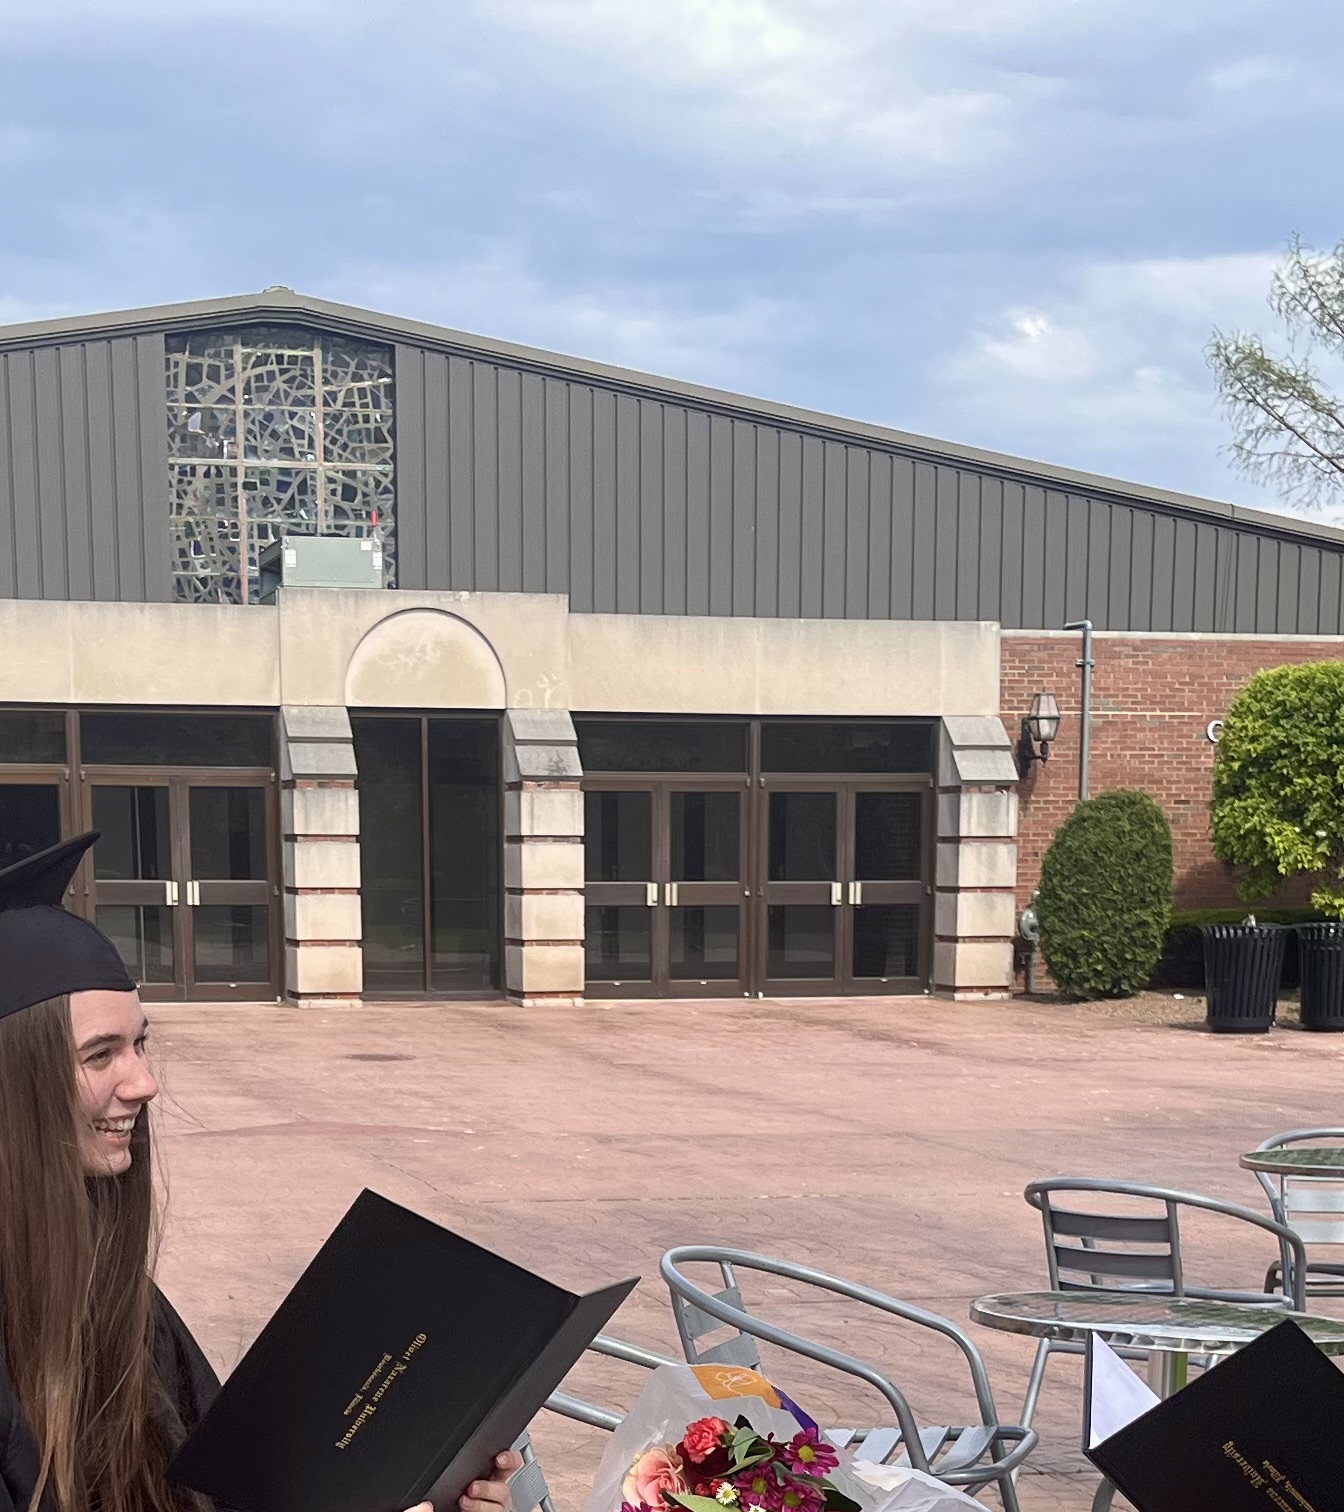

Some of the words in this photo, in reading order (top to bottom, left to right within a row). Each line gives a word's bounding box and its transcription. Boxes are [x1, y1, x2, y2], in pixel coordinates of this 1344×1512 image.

[402, 1332, 427, 1361] Olivet
[372, 1360, 407, 1402] Nazarene
[335, 1402, 377, 1449] University
[1221, 1440, 1268, 1489] University
